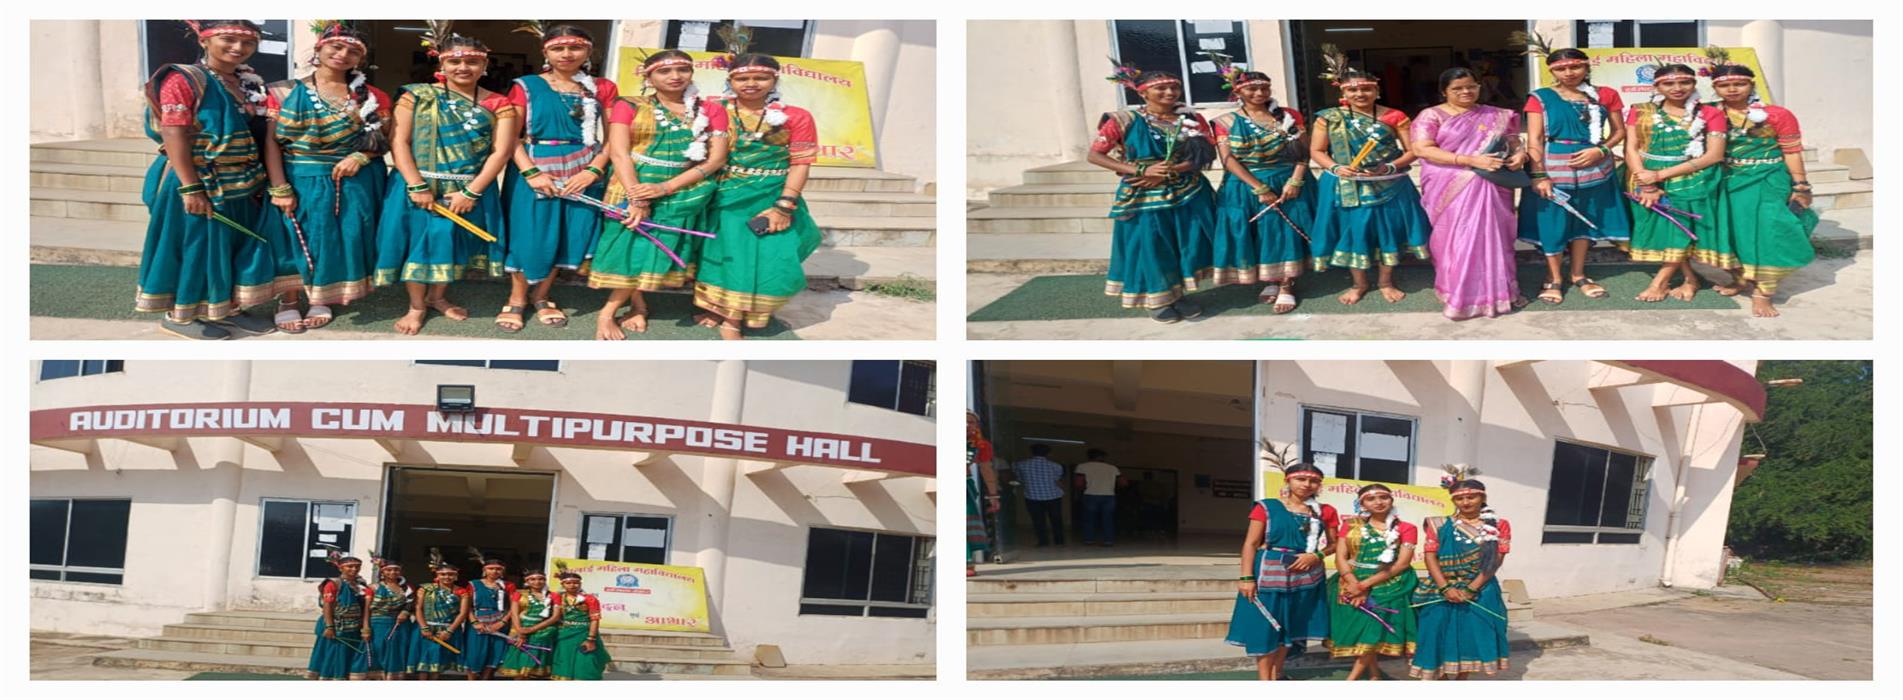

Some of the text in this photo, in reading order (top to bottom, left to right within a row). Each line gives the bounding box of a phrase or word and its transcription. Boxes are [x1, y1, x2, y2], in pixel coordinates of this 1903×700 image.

[780, 63, 852, 88] ाविद्यालय
[69, 407, 881, 464] AUDITORIUM CUM MULTIPURPOSE HALL
[645, 616, 697, 628] आभार
